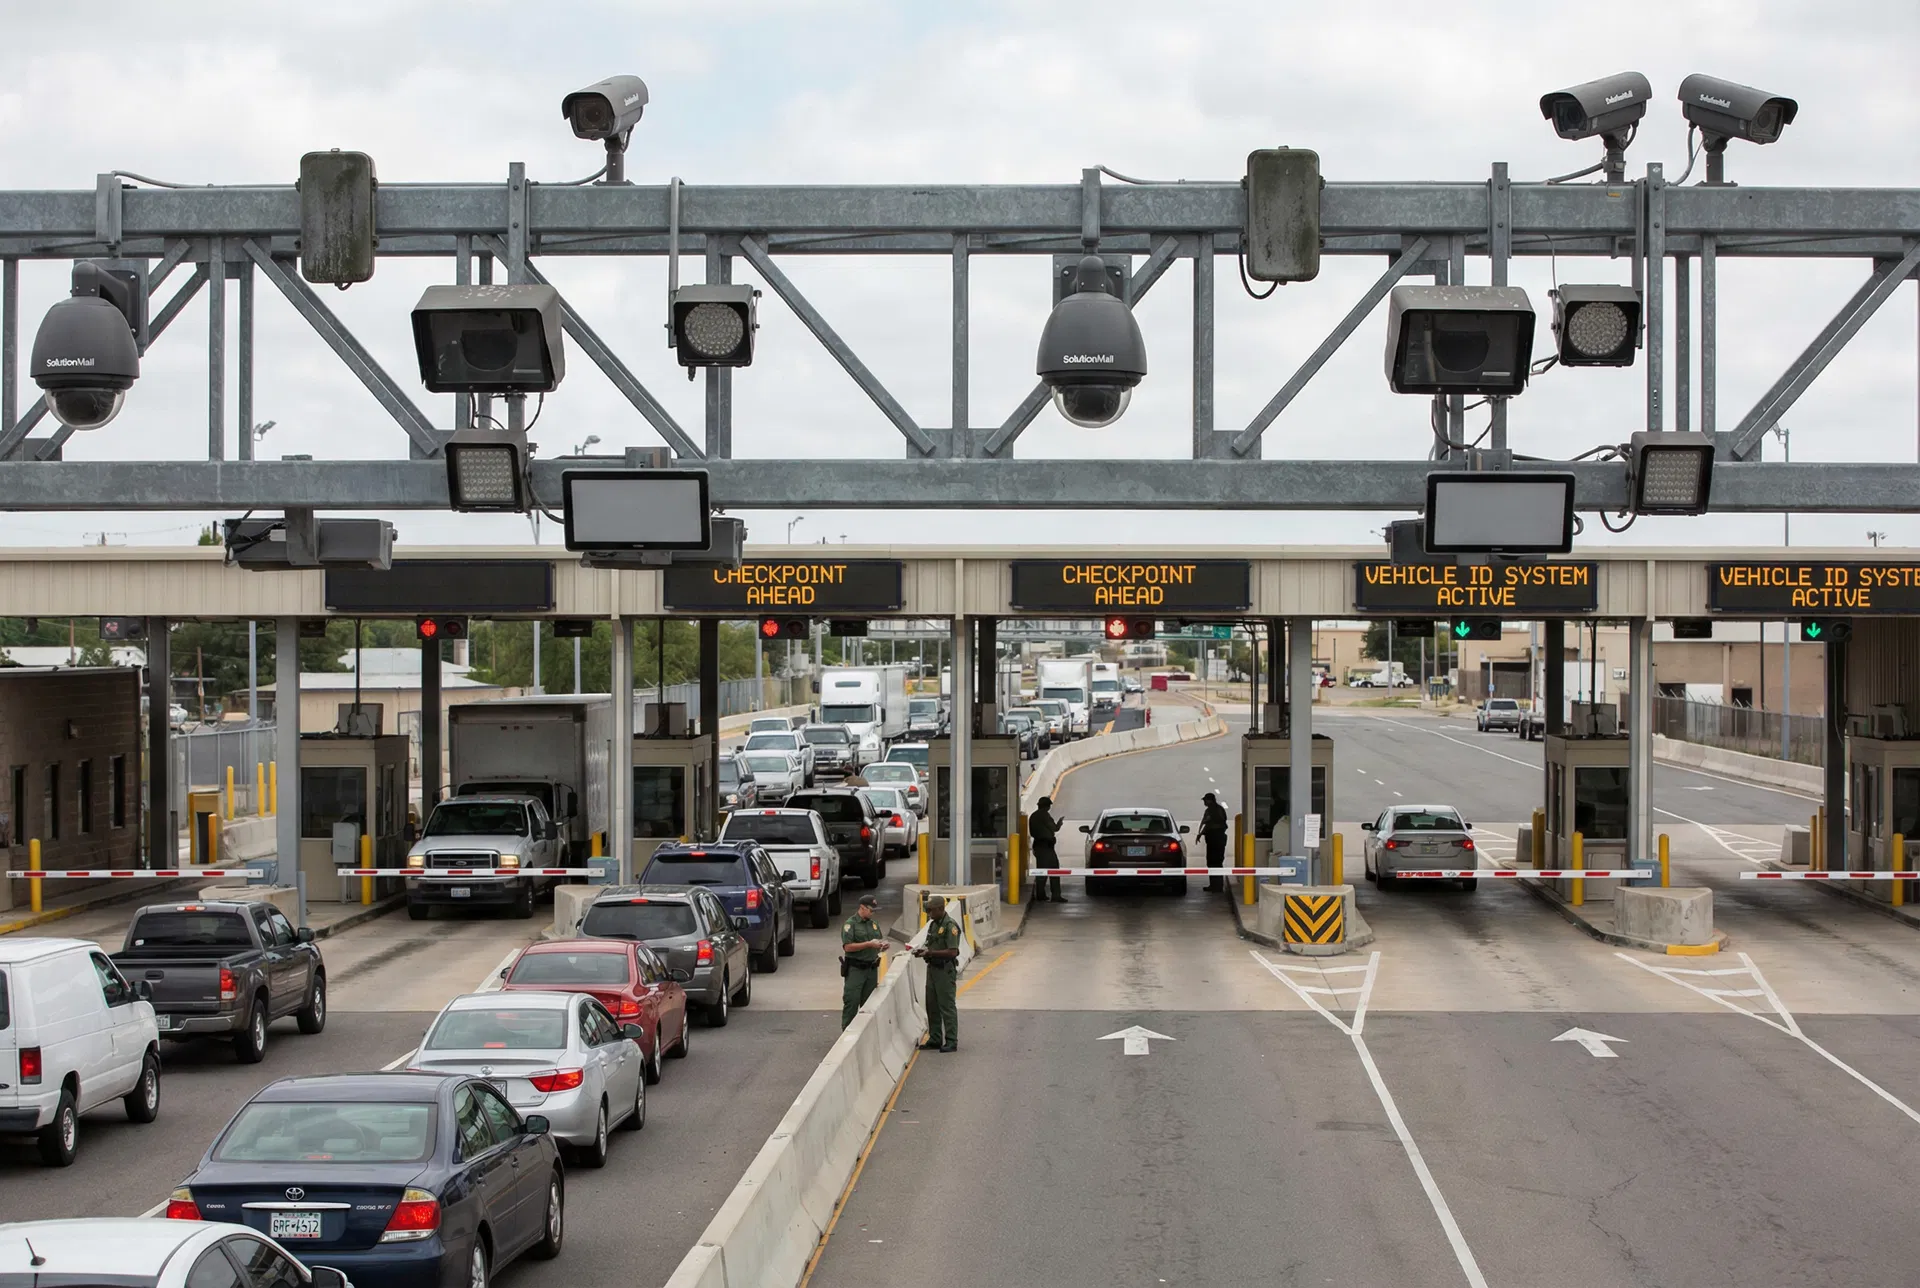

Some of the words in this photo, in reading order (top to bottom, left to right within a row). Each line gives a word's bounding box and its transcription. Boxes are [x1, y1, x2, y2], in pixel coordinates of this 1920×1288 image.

[46, 357, 95, 368] SolutionMall
[1063, 354, 1114, 364] SolutionMall
[714, 565, 847, 584] CHECKPOINT
[1062, 565, 1197, 584] CHECKPOINT
[1365, 566, 1457, 585] VEHICLE
[1470, 566, 1493, 585] ID
[1505, 566, 1588, 585] SYSTEM
[1719, 567, 1812, 586] VEHICLE
[1824, 567, 1848, 586] ID
[746, 586, 815, 605] AHEAD
[1095, 586, 1164, 605] AHEAD
[1437, 587, 1516, 606] ACTIVE
[1792, 588, 1871, 607] ACTIVE
